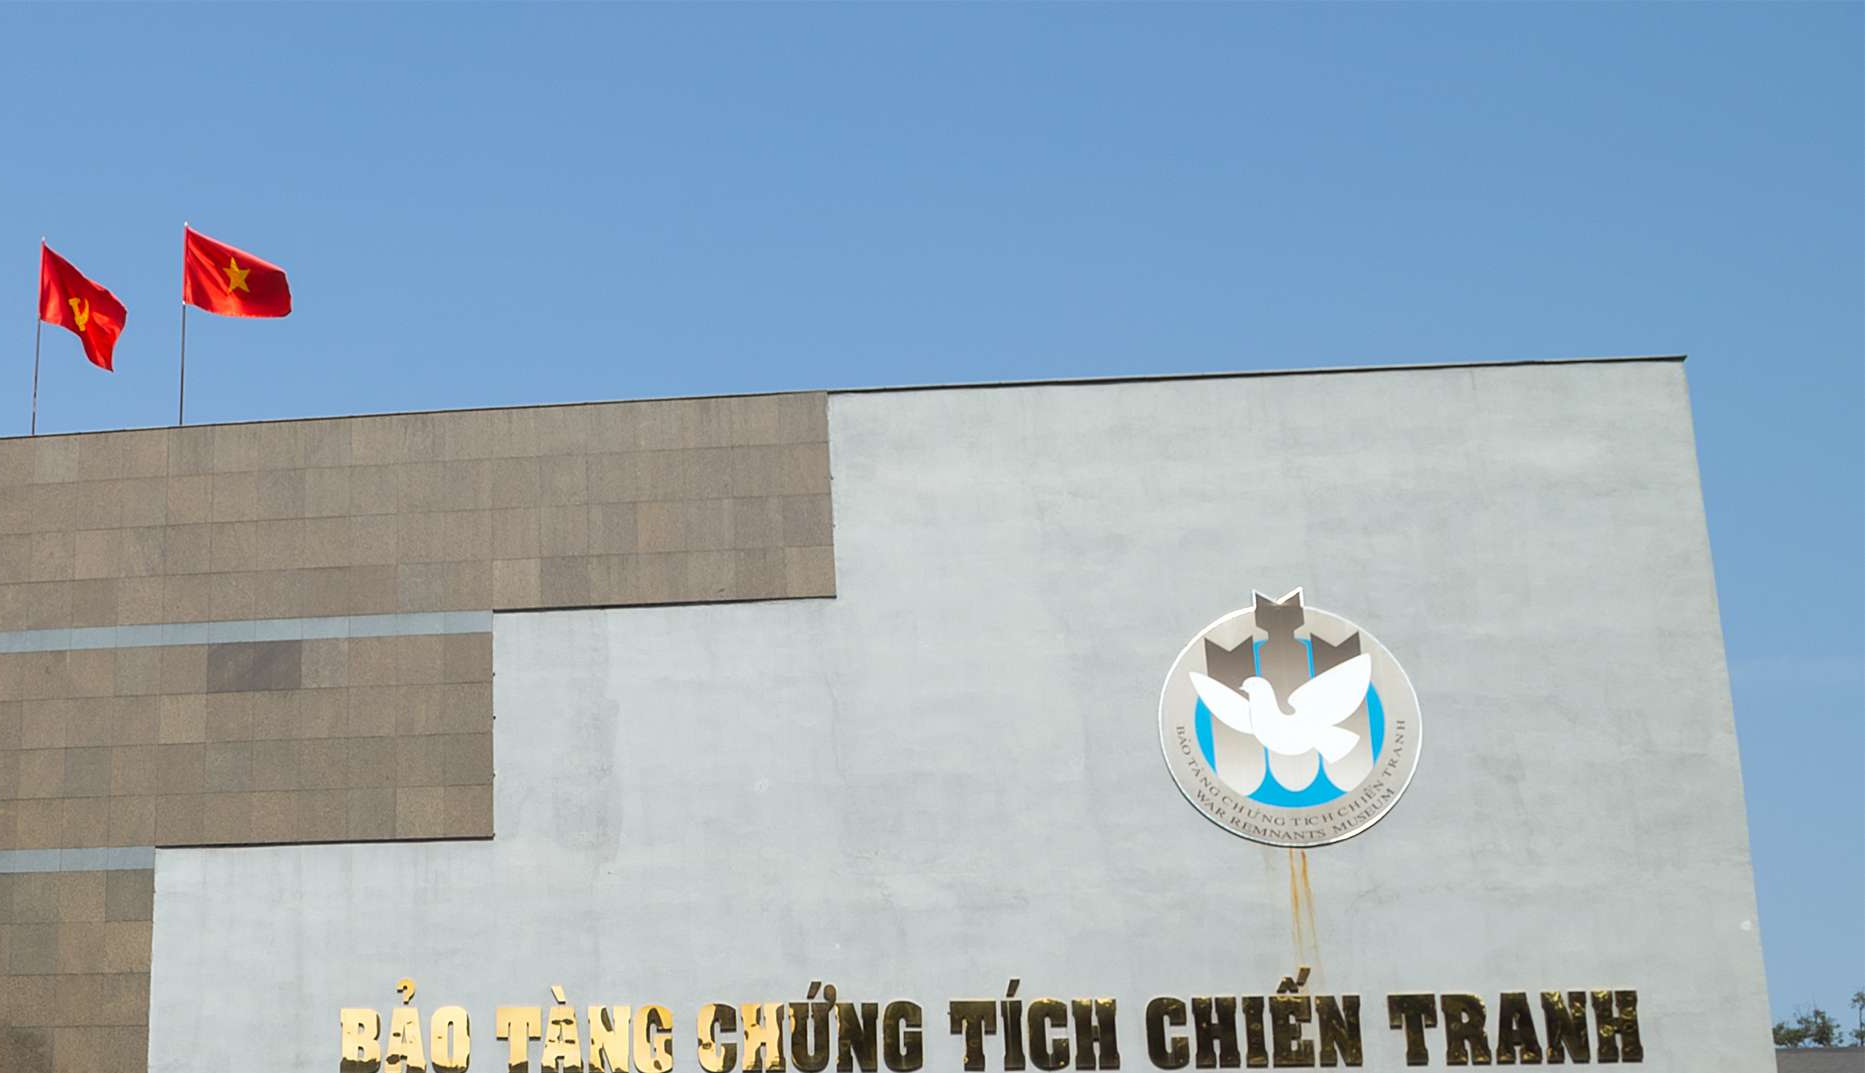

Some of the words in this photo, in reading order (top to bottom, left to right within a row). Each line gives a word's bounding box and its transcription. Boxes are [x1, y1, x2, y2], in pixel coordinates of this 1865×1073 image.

[1383, 720, 1406, 777] TRANH
[1196, 789, 1226, 819] WAR
[1230, 816, 1326, 840] REMNANTS
[1332, 788, 1395, 834] MUSEUM
[949, 978, 1121, 1072] TÍCH
[1145, 966, 1362, 1070] CHIẾN
[1387, 988, 1644, 1067] TRANH
